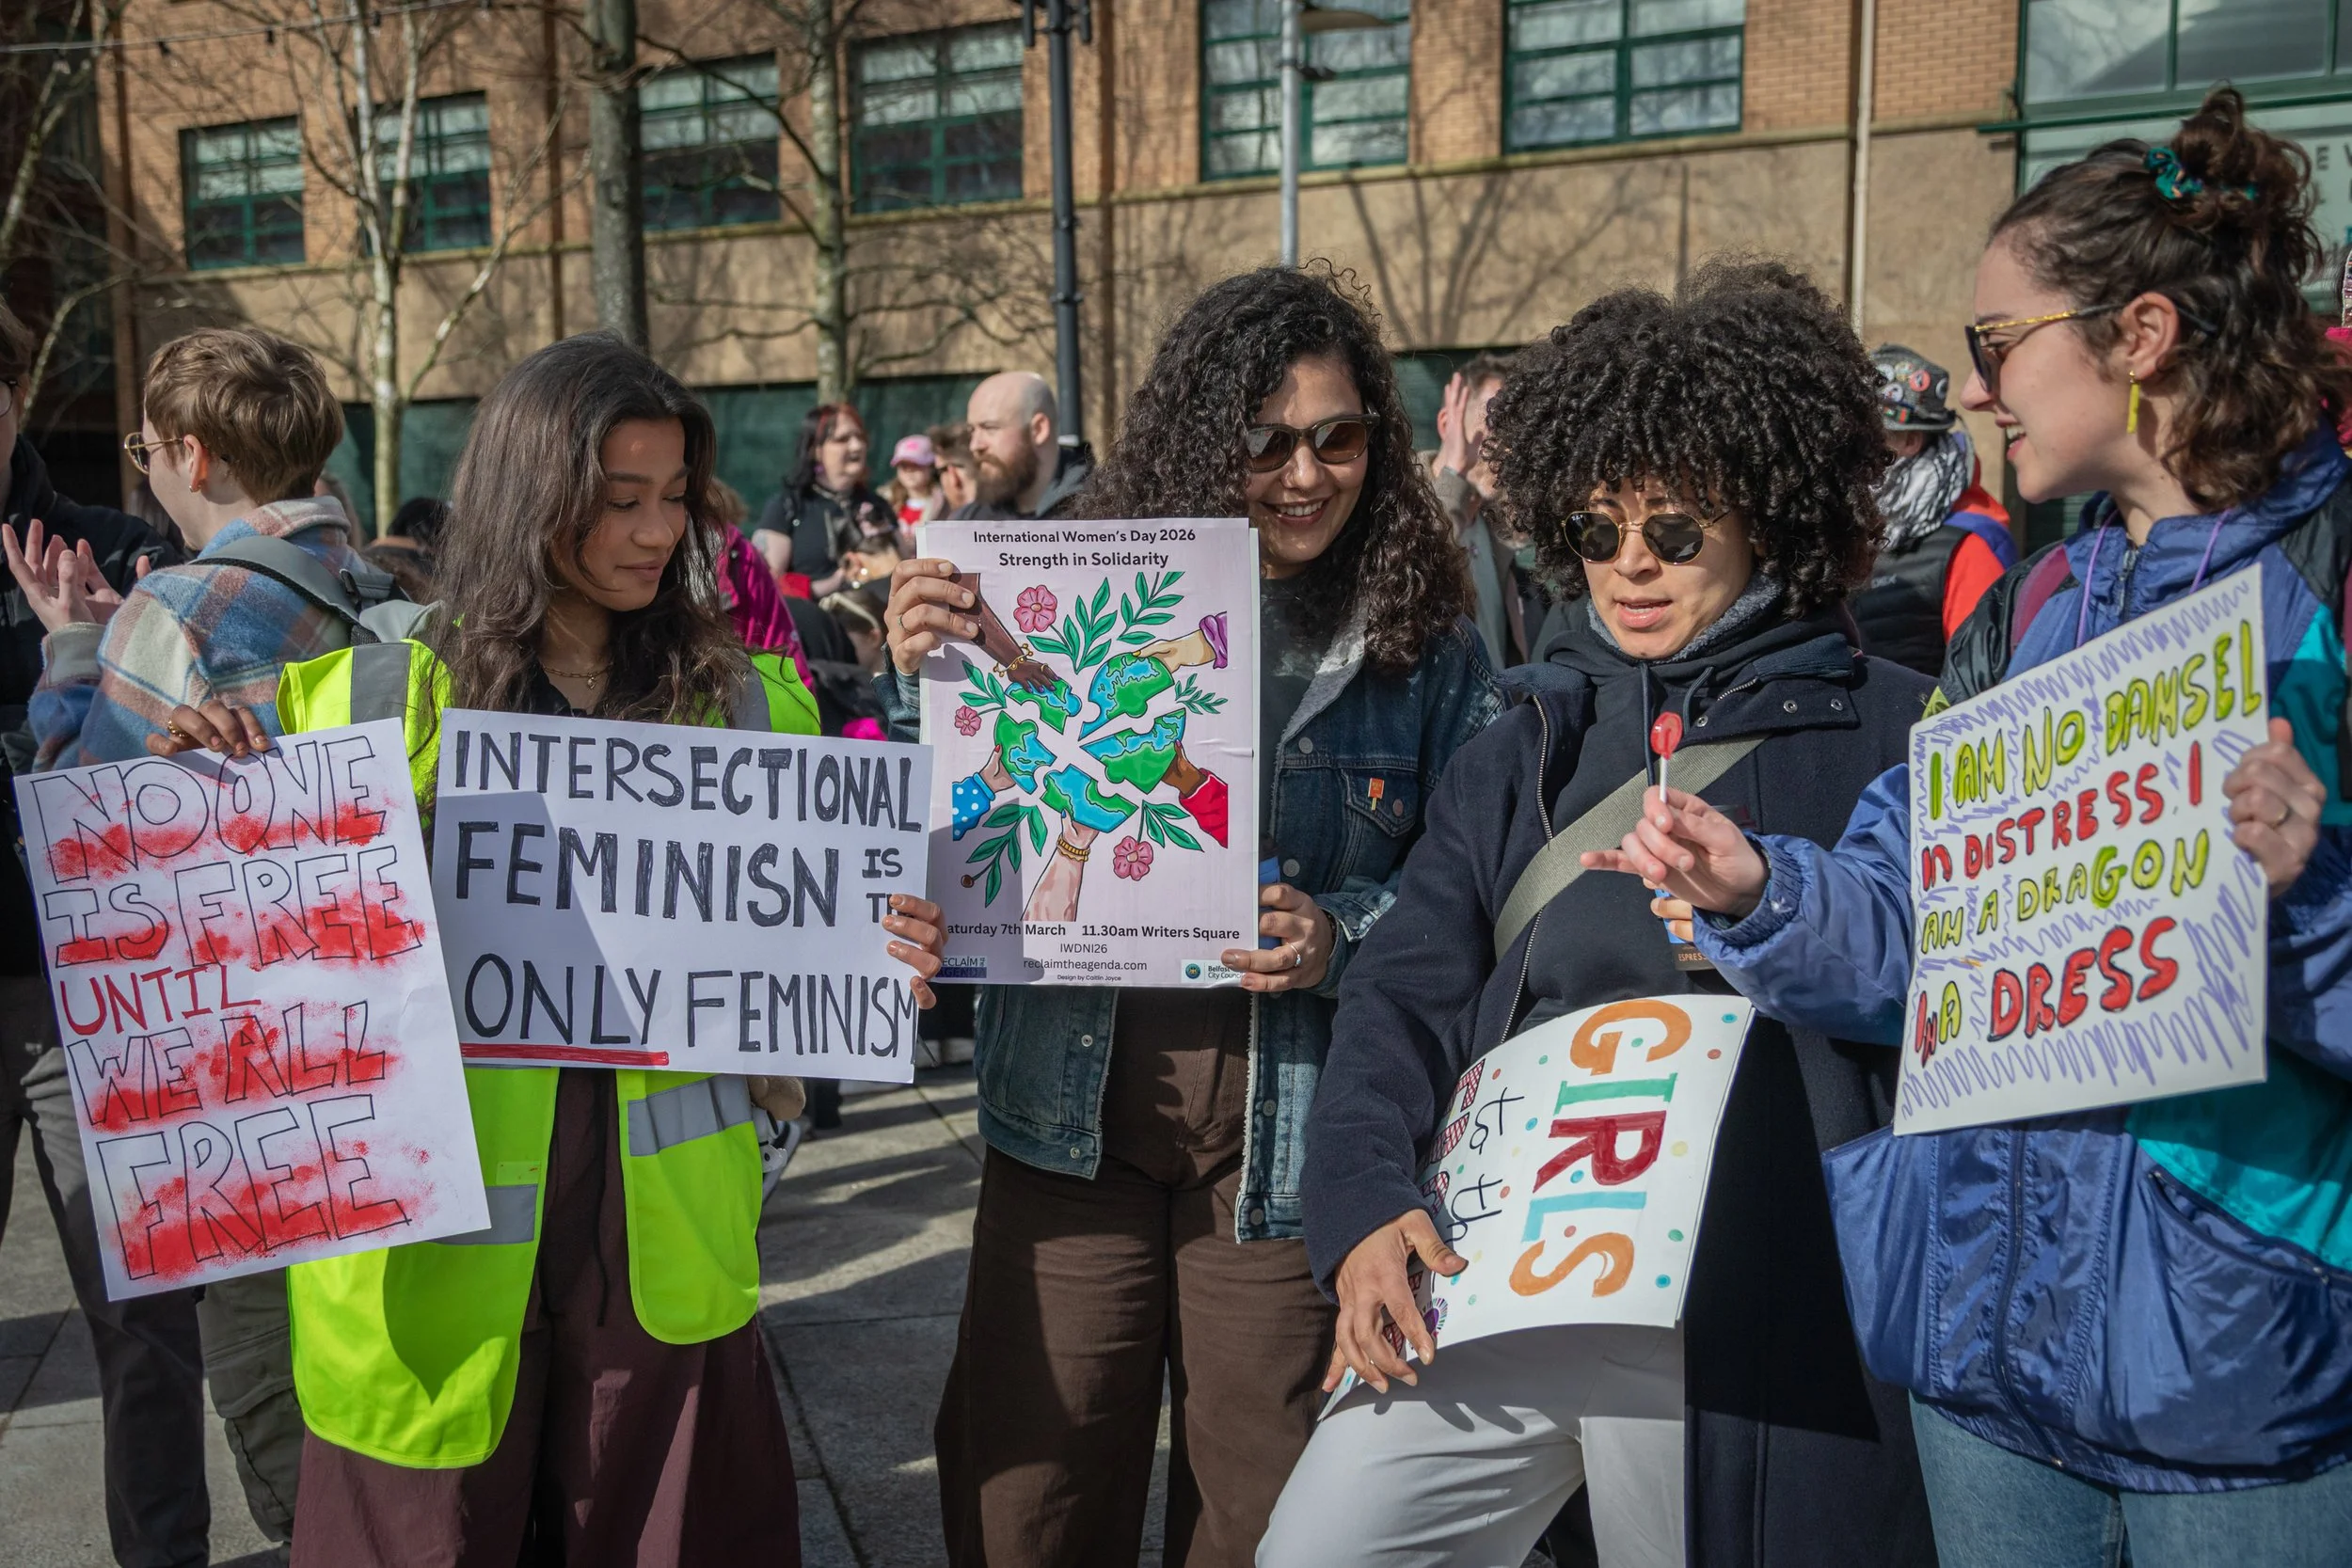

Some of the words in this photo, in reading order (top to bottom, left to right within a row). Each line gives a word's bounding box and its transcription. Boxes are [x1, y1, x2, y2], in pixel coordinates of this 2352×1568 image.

[974, 531, 1059, 544] International
[1063, 530, 1127, 544] Women's
[1131, 530, 1157, 545] Day
[1159, 529, 1196, 542] 2026
[998, 552, 1070, 569] Strength
[1073, 552, 1088, 566] in
[1091, 551, 1169, 569] Solidarity
[1931, 752, 1942, 821] I
[1953, 729, 2005, 809] AM
[2023, 706, 2086, 797] NO
[2105, 619, 2262, 757] DAMSEL
[31, 761, 210, 884] NO
[215, 736, 388, 851] ONE
[454, 730, 922, 832] INTERSECTIONAL
[1963, 763, 2164, 879] DISTRESS
[2188, 740, 2202, 806] I
[43, 883, 170, 968] IS
[174, 846, 422, 968] FREE
[862, 847, 904, 879] IS
[1921, 906, 1964, 954] AM
[1977, 889, 1999, 935] A
[2017, 829, 2210, 922] DRAGON
[941, 956, 978, 967] ECLAIM
[947, 923, 998, 938] aturday
[1000, 924, 1022, 935] 7th
[1025, 924, 1066, 936] March
[1024, 958, 1148, 972] reclaimtheagenda.com
[1060, 943, 1108, 954] IWDNI26
[1082, 925, 1138, 938] 11.30am
[1141, 926, 1190, 939] Writers
[1192, 927, 1240, 942] Square
[1938, 980, 1963, 1045] A
[1987, 915, 2179, 1042] DRESS
[58, 965, 262, 1037] UNTIL
[465, 953, 662, 1046] ONLY
[688, 967, 917, 1065] FEMINISM
[67, 1027, 200, 1127] WE
[220, 1001, 387, 1103] ALL
[1470, 1087, 1525, 1155] to
[1509, 999, 1692, 1298] GIRLS
[97, 1094, 413, 1281] FREE
